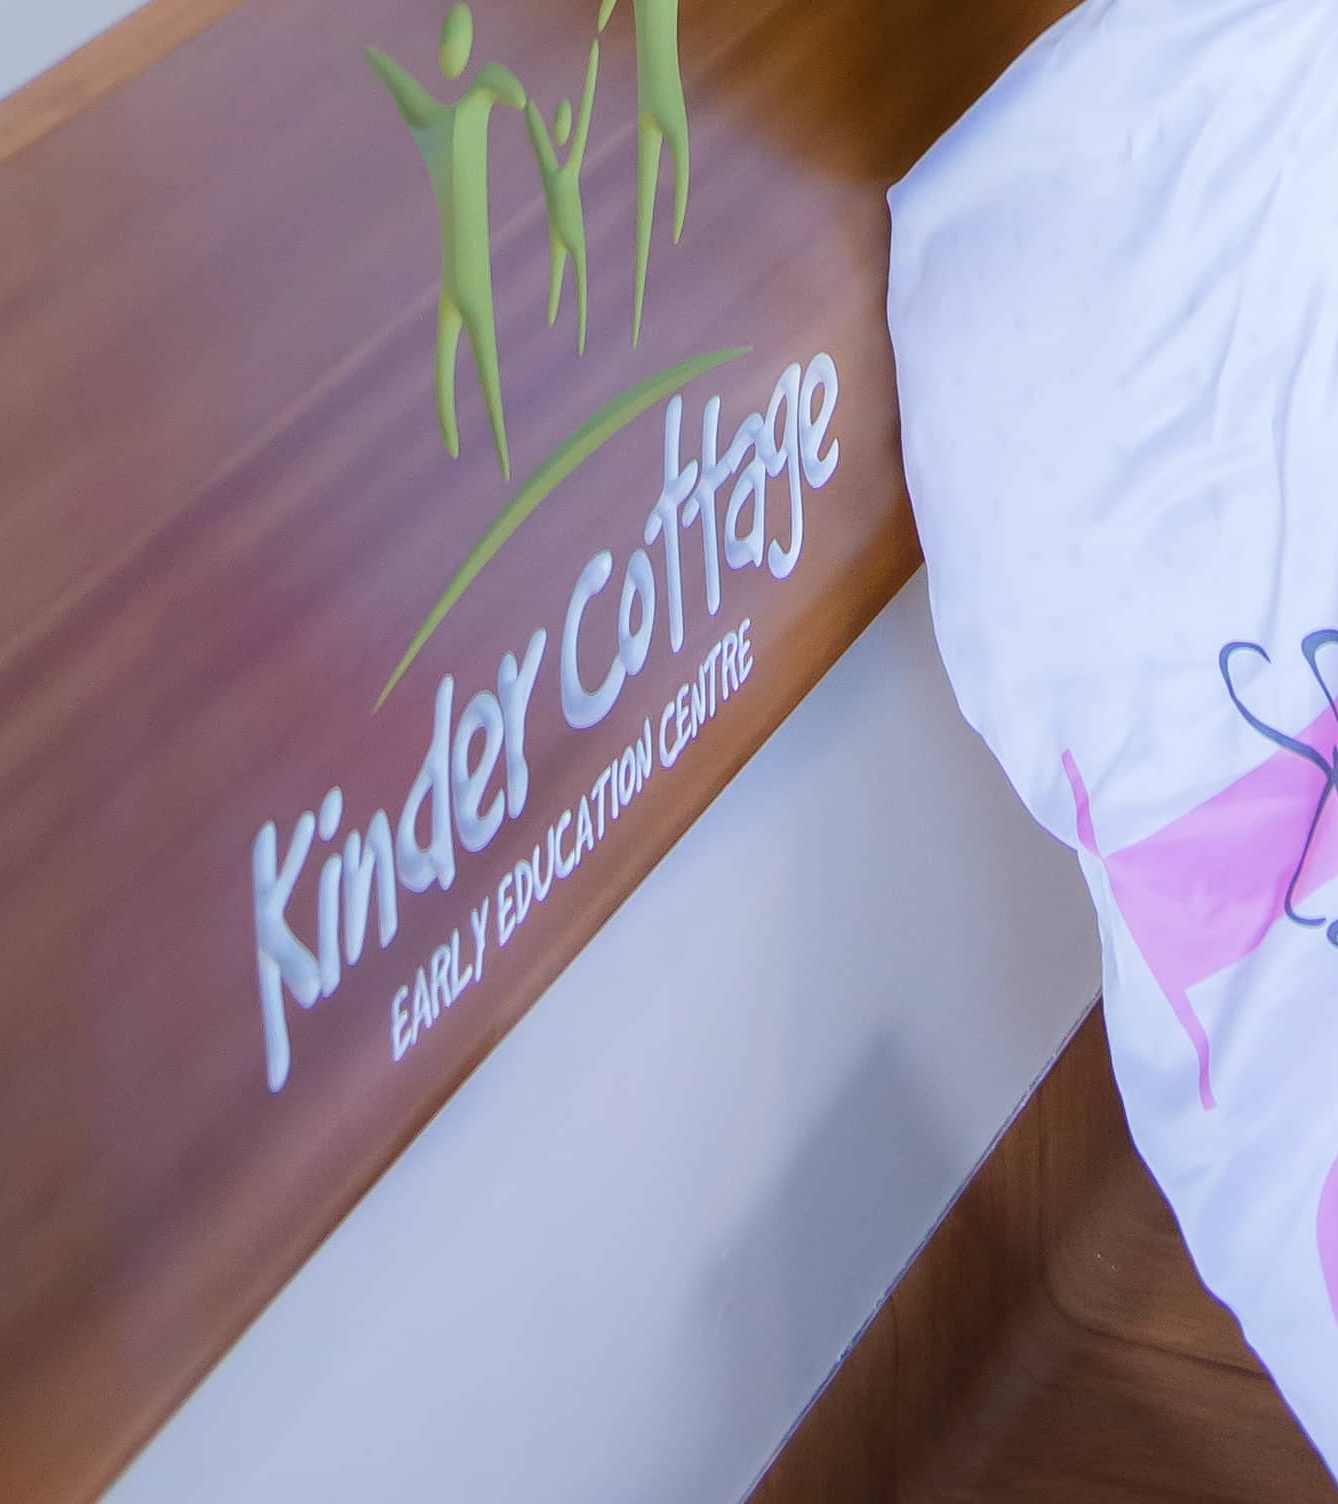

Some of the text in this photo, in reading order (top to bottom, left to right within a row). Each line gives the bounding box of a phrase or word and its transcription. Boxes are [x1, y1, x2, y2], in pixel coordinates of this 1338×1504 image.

[252, 352, 840, 1092] Kinder Cottage
[390, 617, 754, 1063] EARLY EDUCATION CENTRE
